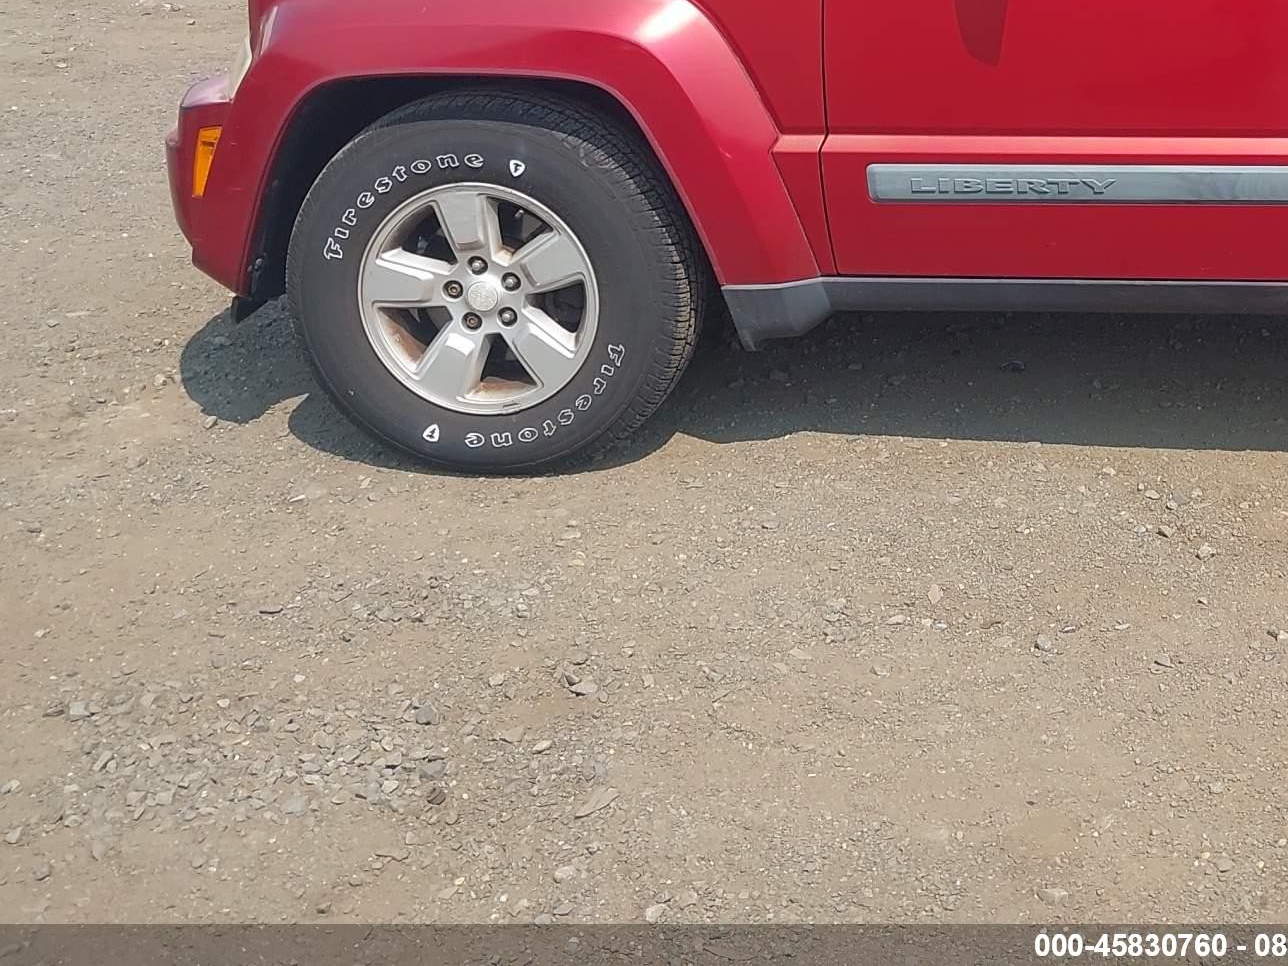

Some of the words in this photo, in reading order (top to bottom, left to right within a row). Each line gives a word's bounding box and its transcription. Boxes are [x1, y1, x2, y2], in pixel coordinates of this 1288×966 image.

[323, 152, 484, 260] Firestone
[910, 177, 1116, 195] LIBERTY
[464, 342, 624, 449] Firestone
